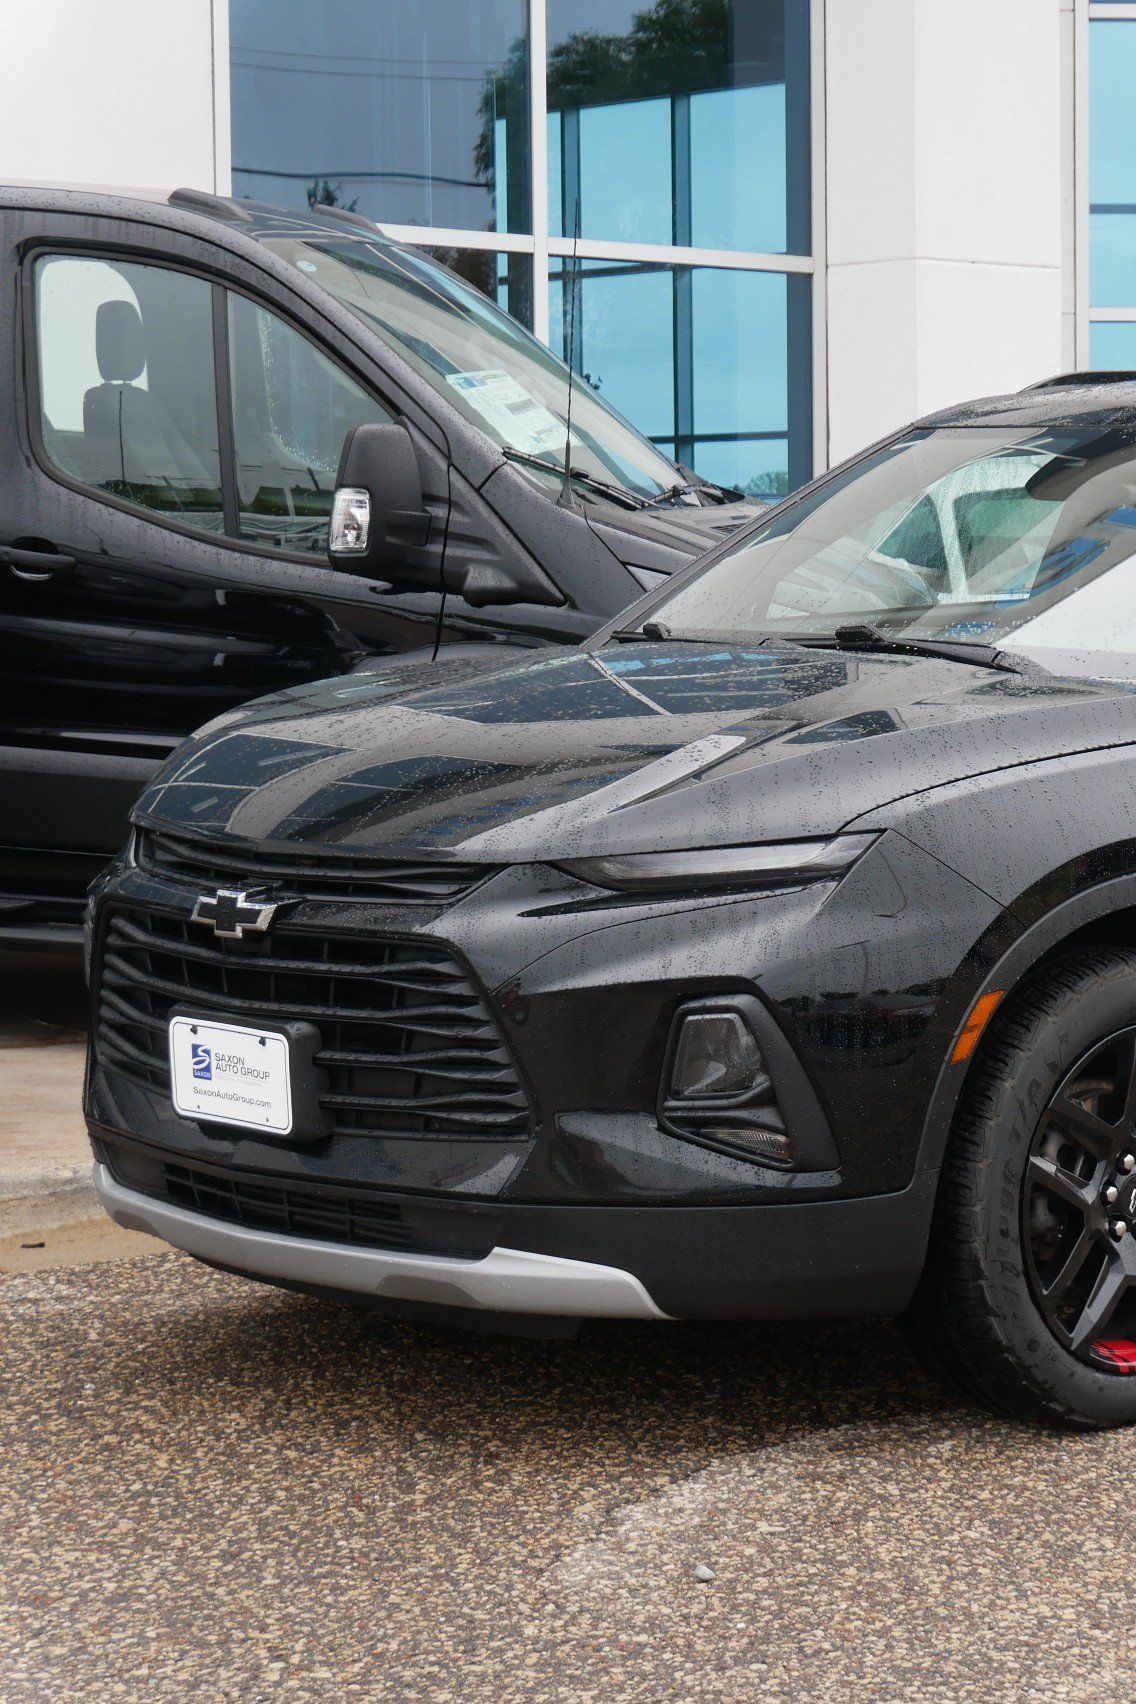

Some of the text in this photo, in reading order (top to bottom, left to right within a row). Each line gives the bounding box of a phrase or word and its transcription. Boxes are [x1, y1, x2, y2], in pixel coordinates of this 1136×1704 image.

[214, 1052, 245, 1066] SAXON
[194, 1070, 211, 1079] SAXON
[215, 1063, 270, 1080] AUTO GROUP
[193, 1085, 272, 1109] SaxonAutoGroup.com
